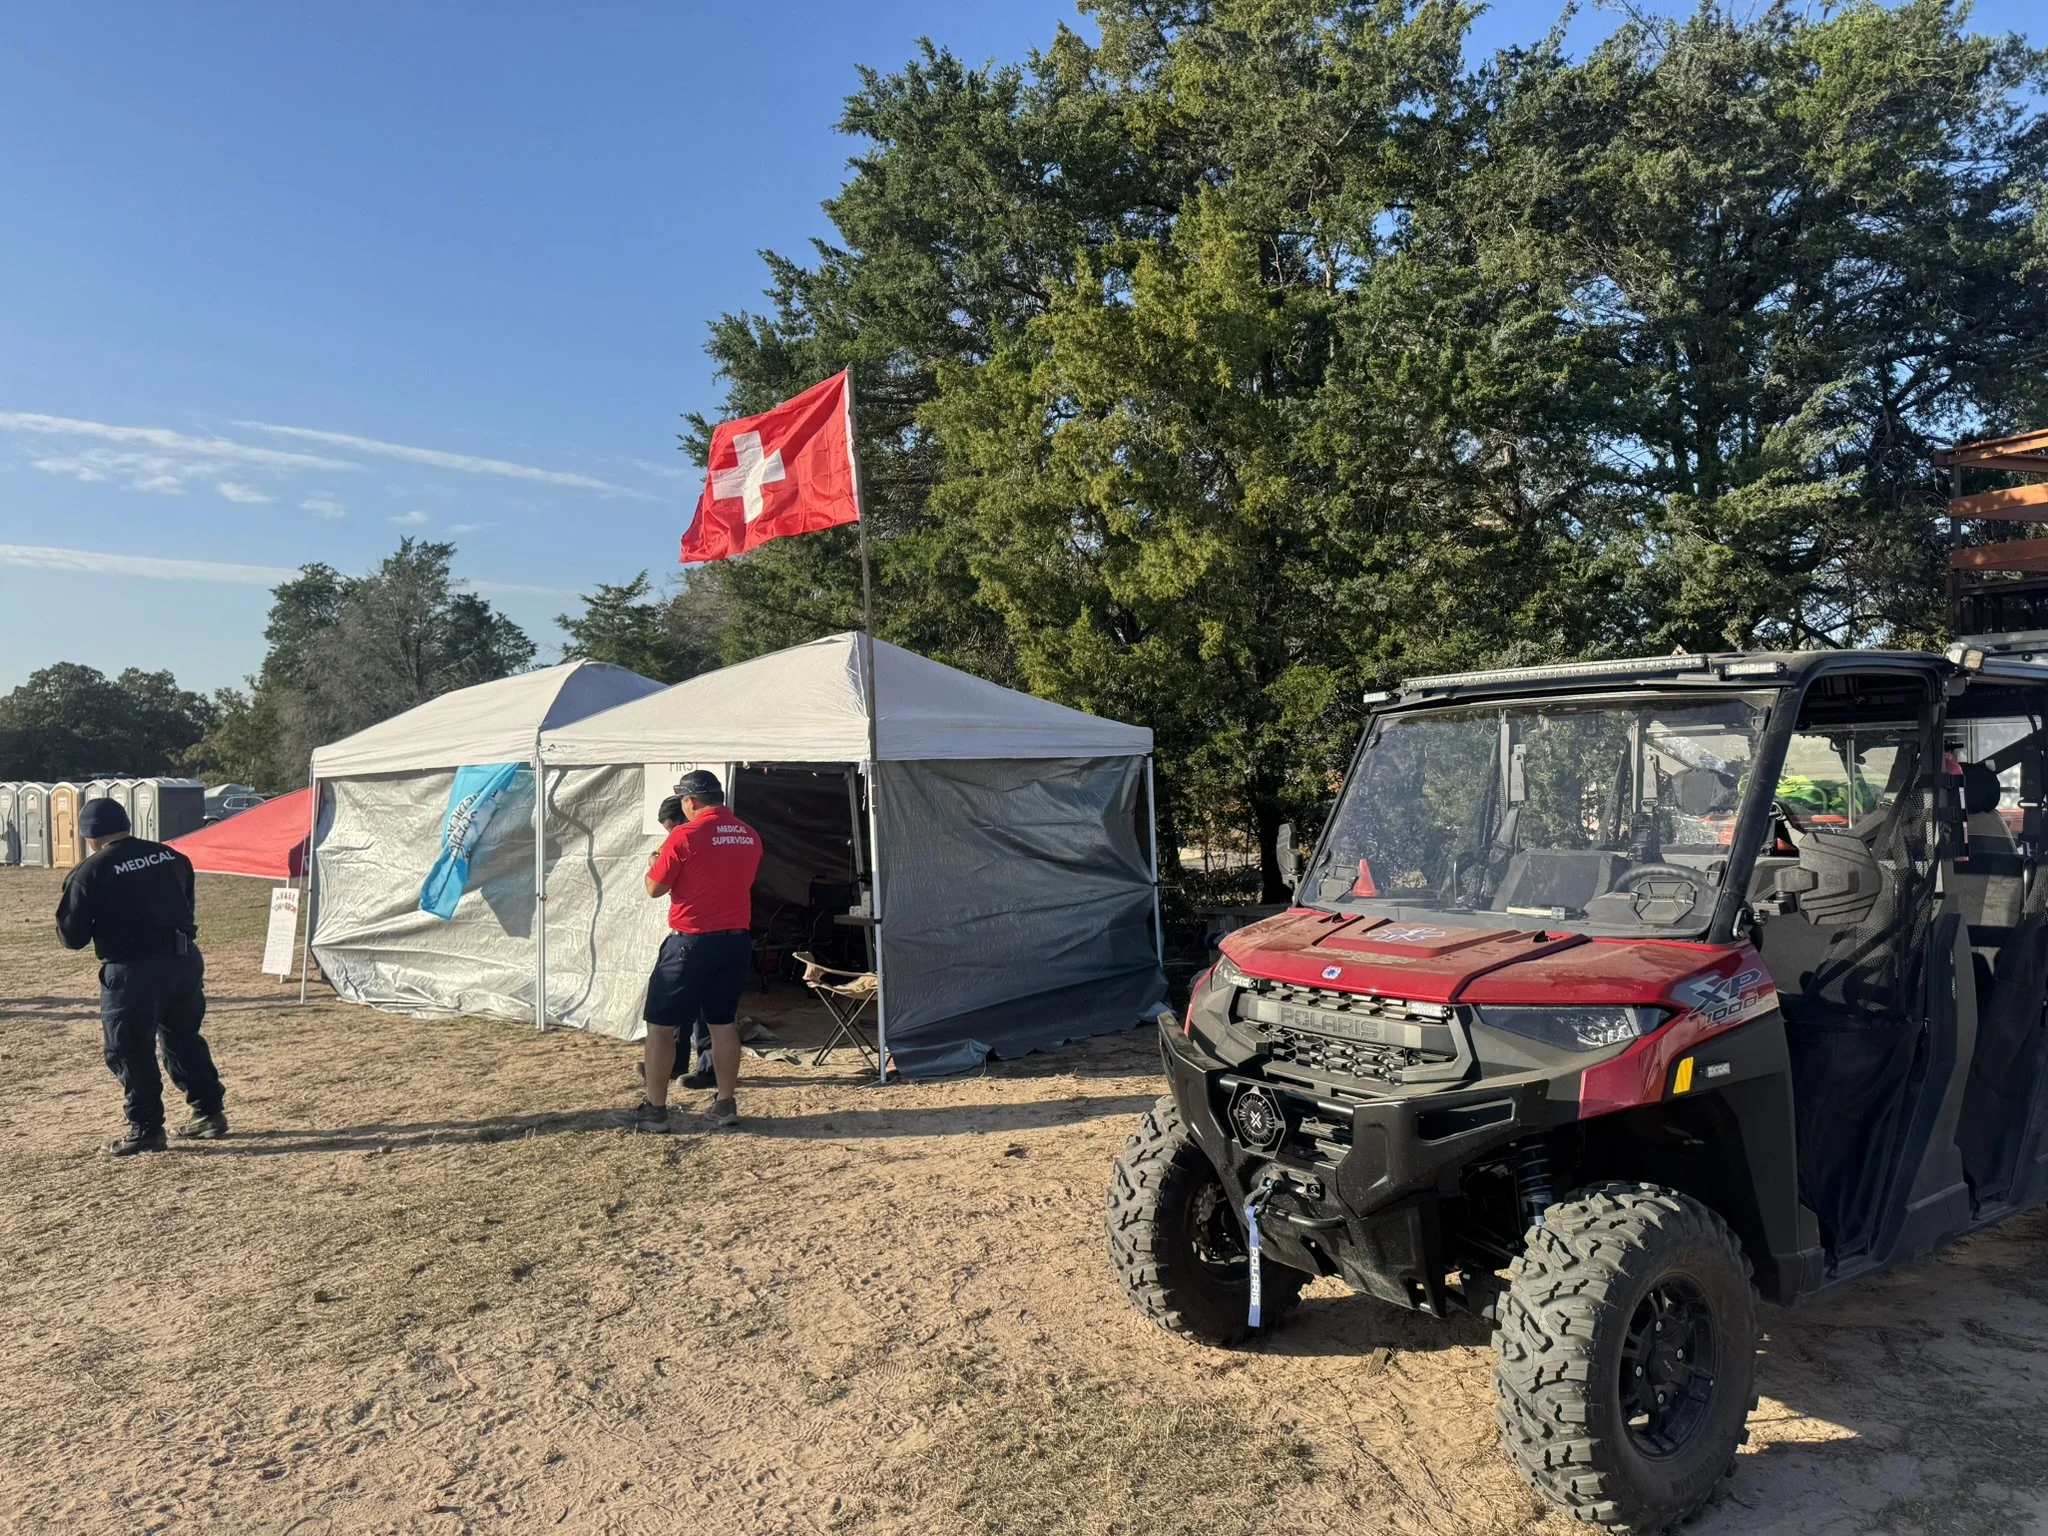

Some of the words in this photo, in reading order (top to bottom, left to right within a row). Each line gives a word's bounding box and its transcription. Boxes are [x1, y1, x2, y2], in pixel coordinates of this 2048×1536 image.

[712, 836, 755, 847] SUPERVISOR
[716, 825, 748, 834] MEDICAL
[113, 850, 176, 875] MEDICAL
[1686, 967, 1762, 1018] XP
[1280, 1006, 1380, 1038] POLARIS
[1706, 996, 1757, 1024] 1000
[1249, 1246, 1260, 1306] POLARIS
